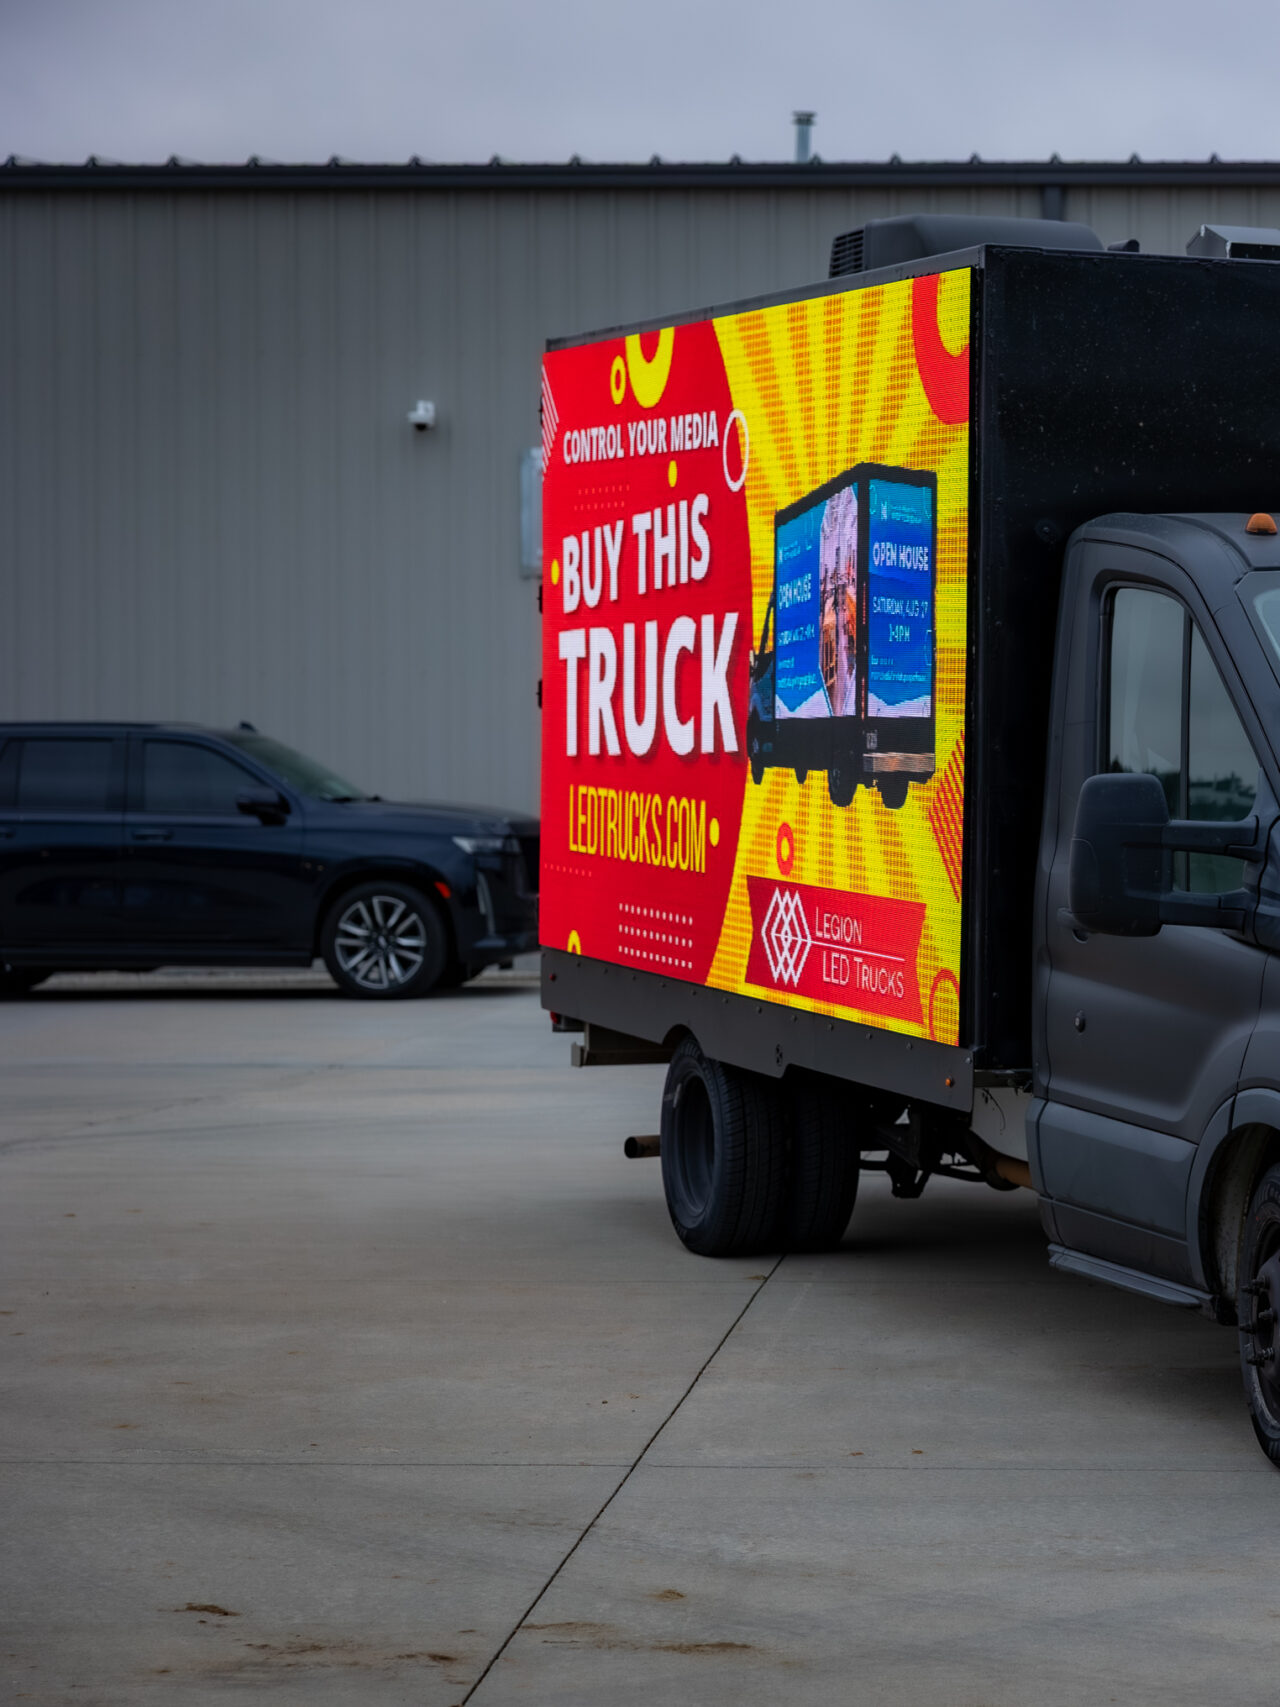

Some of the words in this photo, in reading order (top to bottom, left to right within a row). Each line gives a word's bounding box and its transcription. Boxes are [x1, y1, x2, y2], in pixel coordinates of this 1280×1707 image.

[564, 424, 625, 465] CONTROL
[627, 417, 668, 457] YOUR
[670, 410, 719, 452] MEDIA
[562, 519, 625, 614] BUY
[631, 493, 711, 595] THIS
[872, 541, 897, 567] OPEN
[898, 545, 929, 571] HOUSE
[558, 611, 739, 758] TRUCK
[569, 785, 706, 874] LEDTRUCKS.COM
[822, 951, 850, 985] LED
